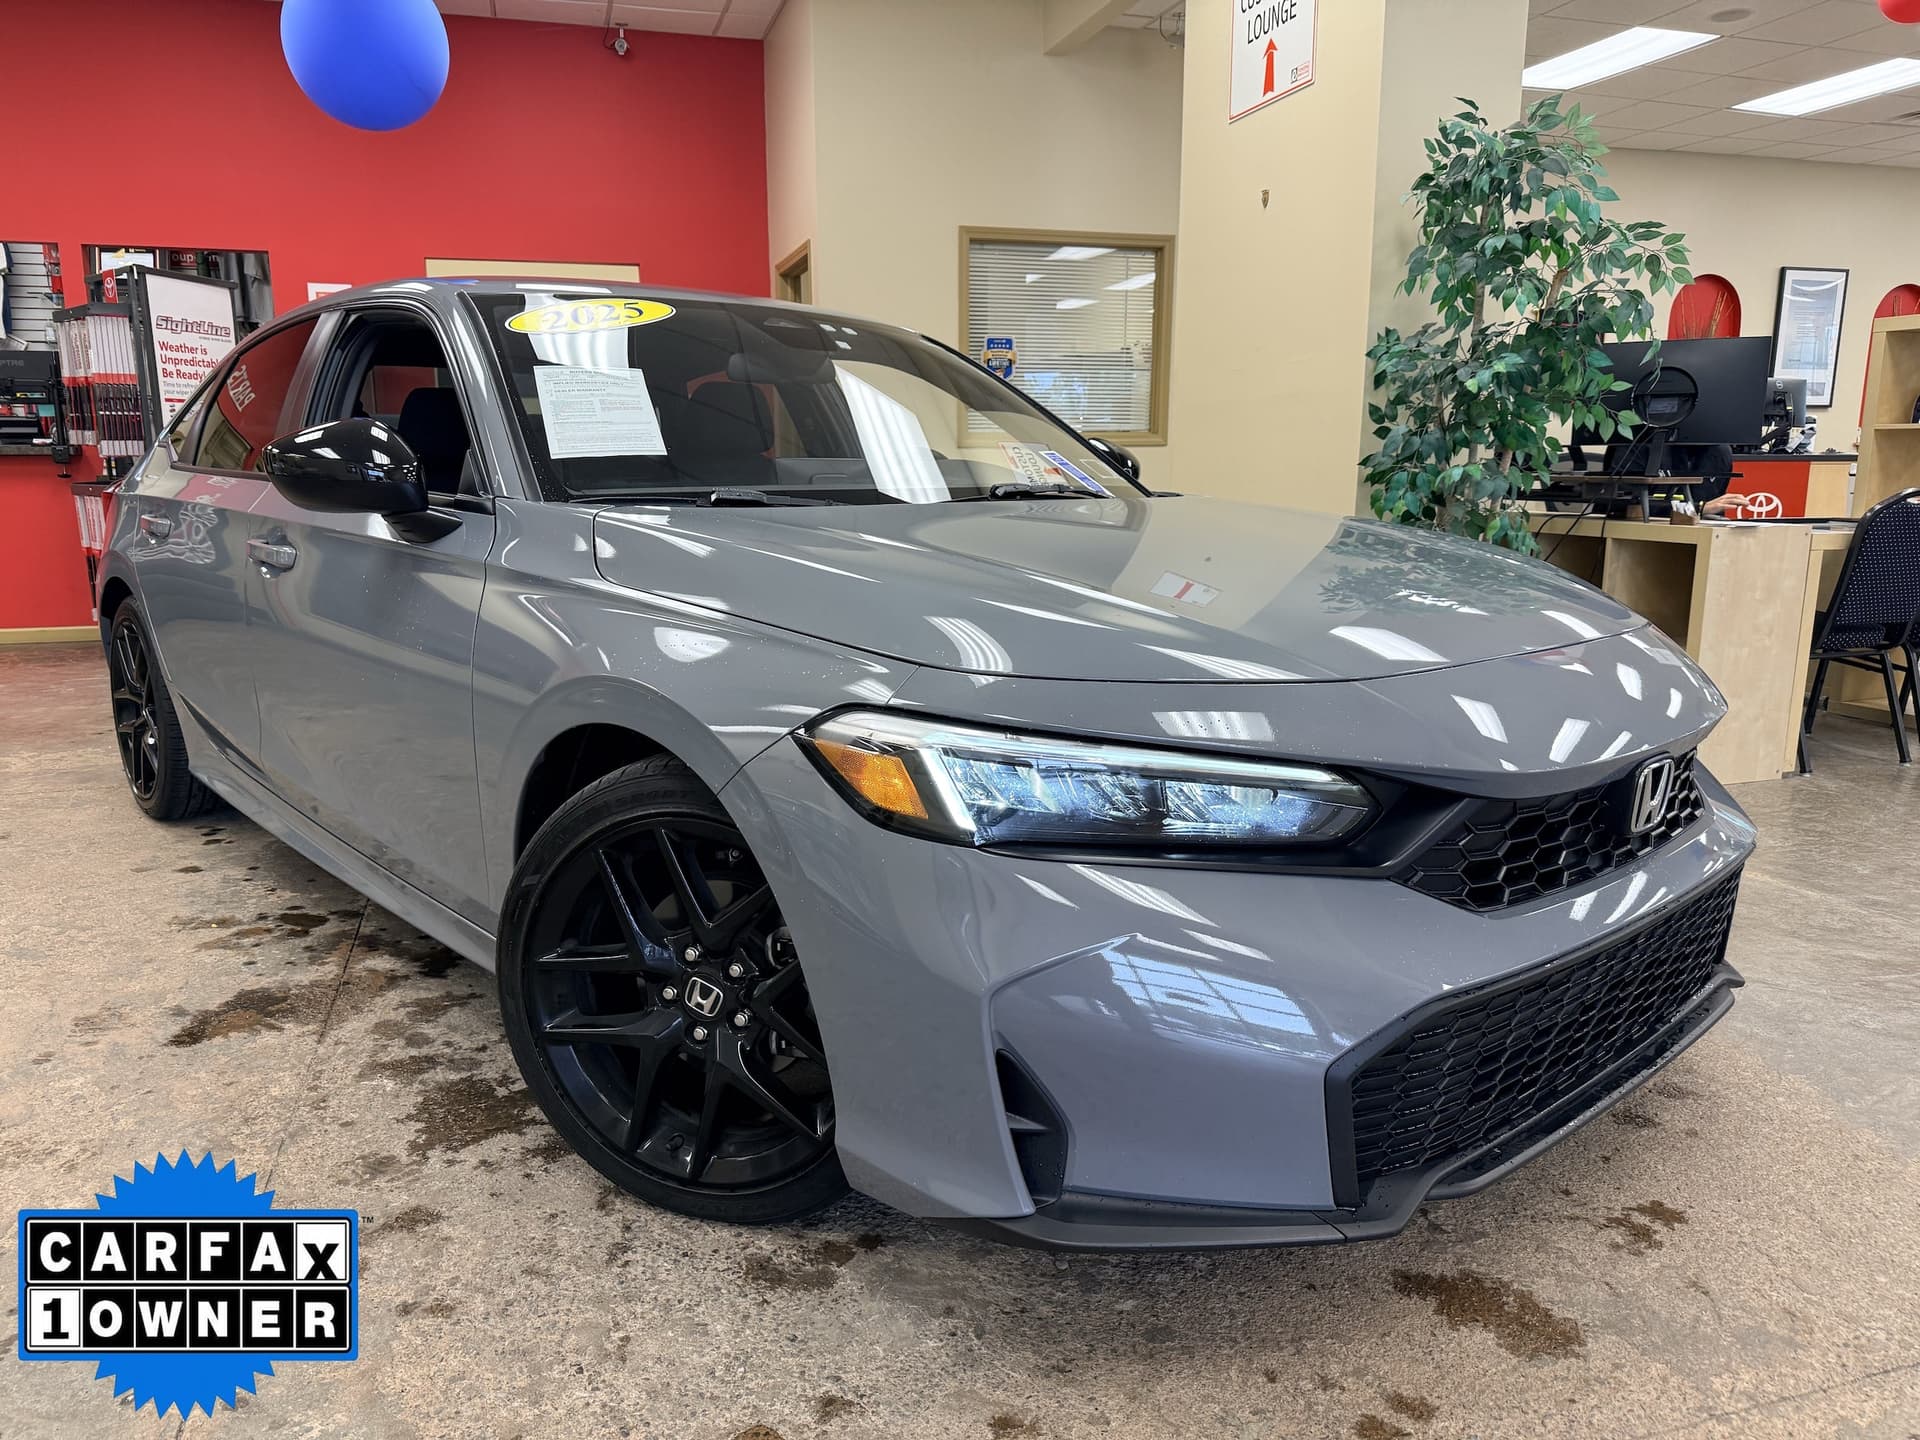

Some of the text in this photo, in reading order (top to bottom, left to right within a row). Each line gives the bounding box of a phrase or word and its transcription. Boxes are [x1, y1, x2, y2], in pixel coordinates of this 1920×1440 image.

[1247, 0, 1297, 44] LOUNGE
[156, 315, 231, 337] SightLine
[543, 302, 645, 330] 2025
[158, 341, 208, 355] Weather is
[162, 368, 174, 378] Be
